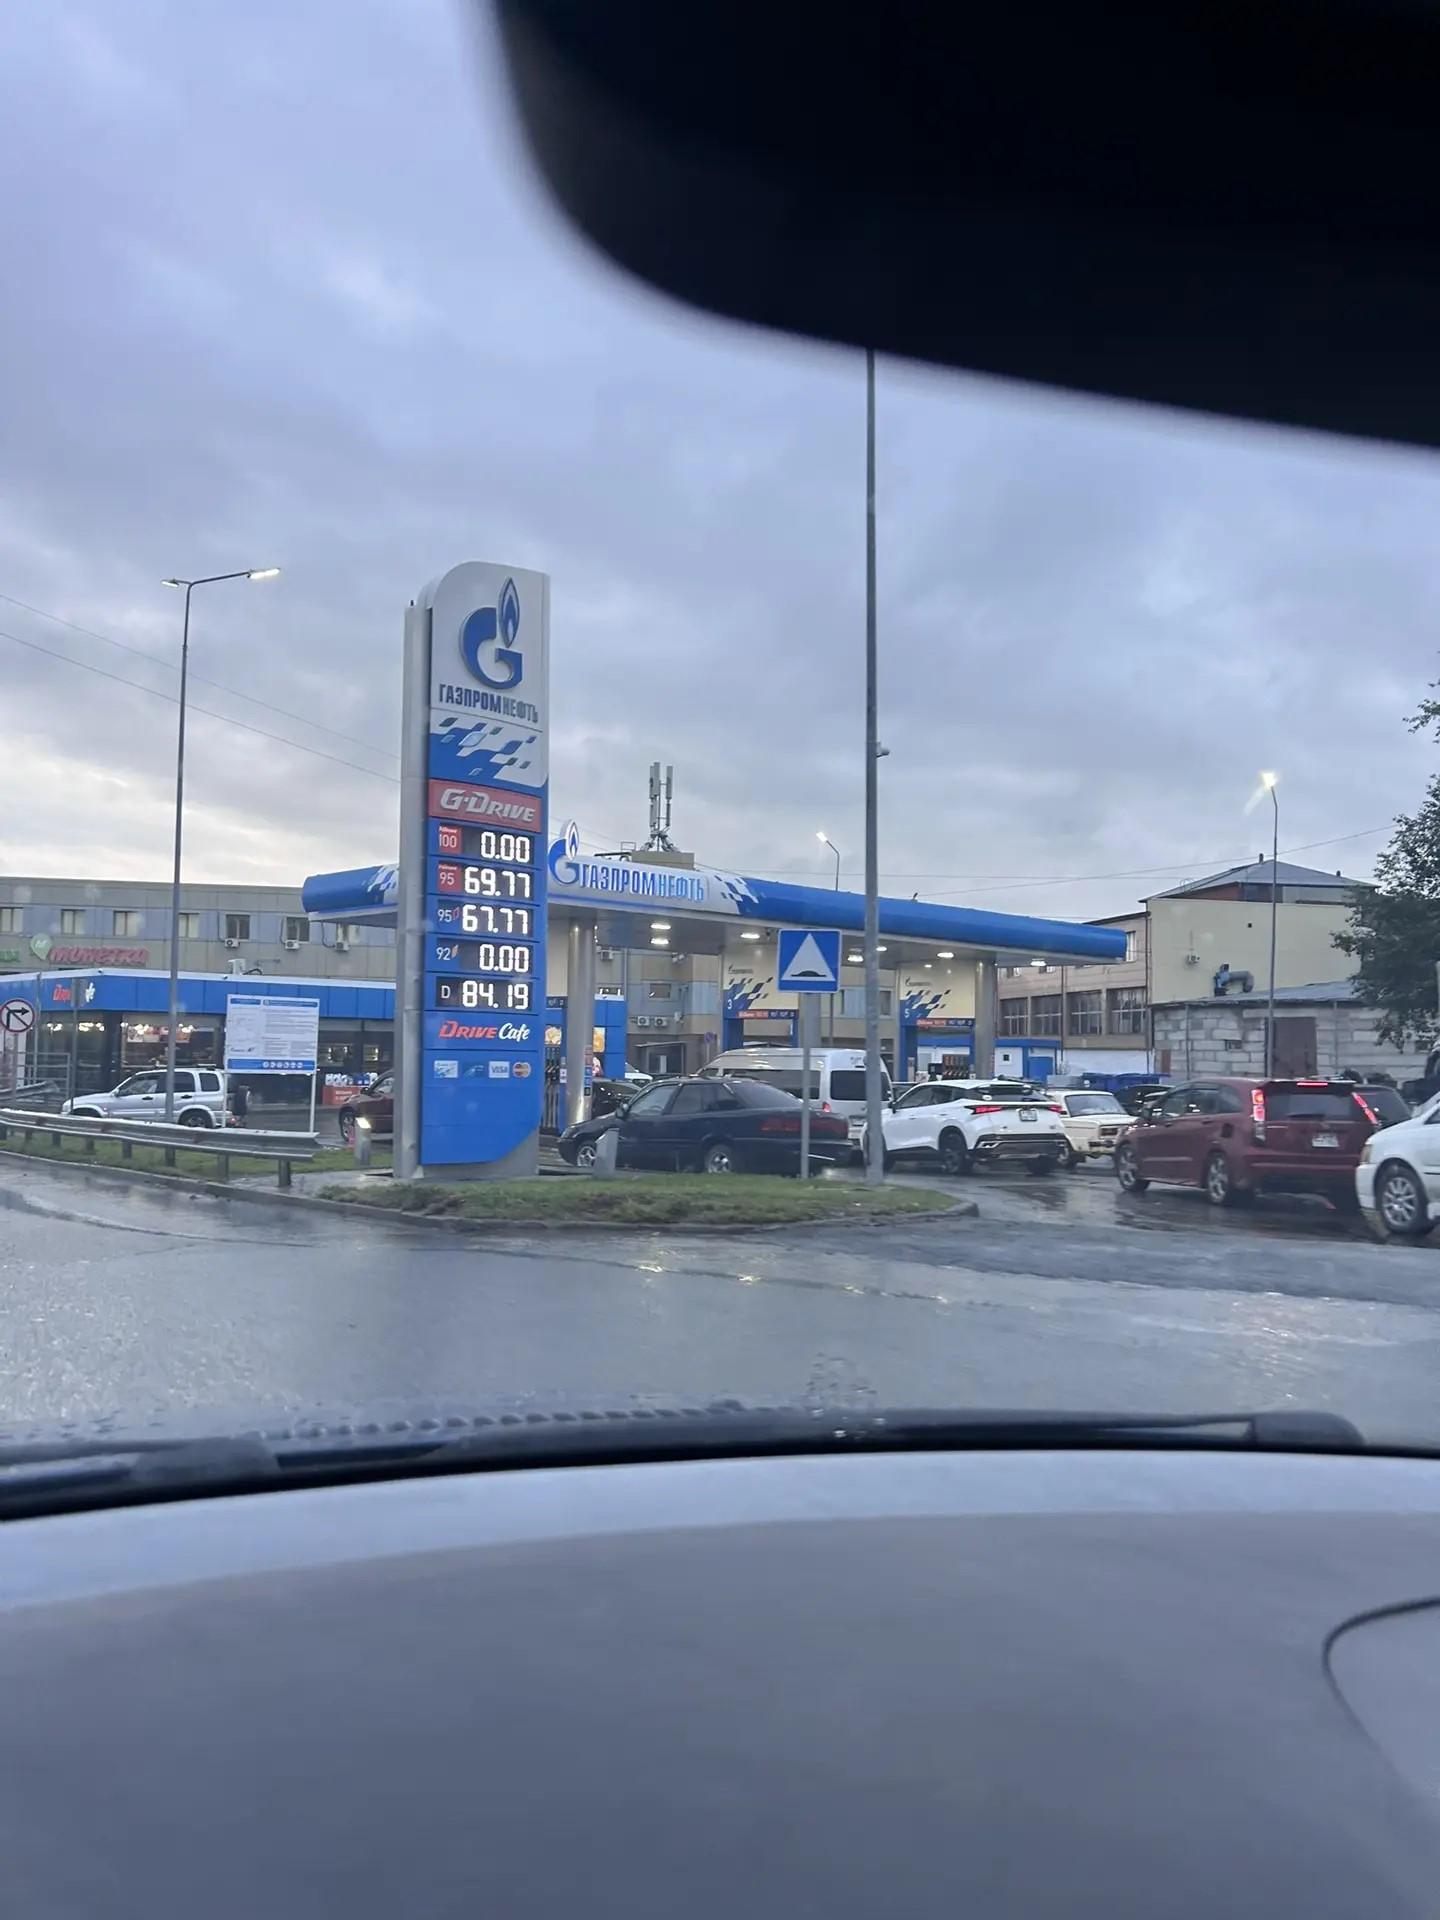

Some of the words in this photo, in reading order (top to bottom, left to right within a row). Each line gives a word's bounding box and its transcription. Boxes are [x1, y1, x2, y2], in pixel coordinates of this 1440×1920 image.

[439, 683, 538, 723] ГАЗПРОМНЕФТЬ
[439, 834, 457, 848] 100
[480, 831, 530, 863] 0.00
[439, 872, 455, 886] 95
[464, 866, 531, 898] 69.77
[437, 909, 453, 923] 95
[462, 904, 529, 934] 67.77
[436, 947, 451, 961] 92
[479, 943, 530, 973] 0.00
[441, 985, 451, 999] D
[462, 980, 529, 1010] 84.19
[727, 999, 733, 1010] 3
[904, 1008, 911, 1019] 5
[439, 1020, 498, 1040] DRIVE
[498, 1022, 531, 1042] Cafe
